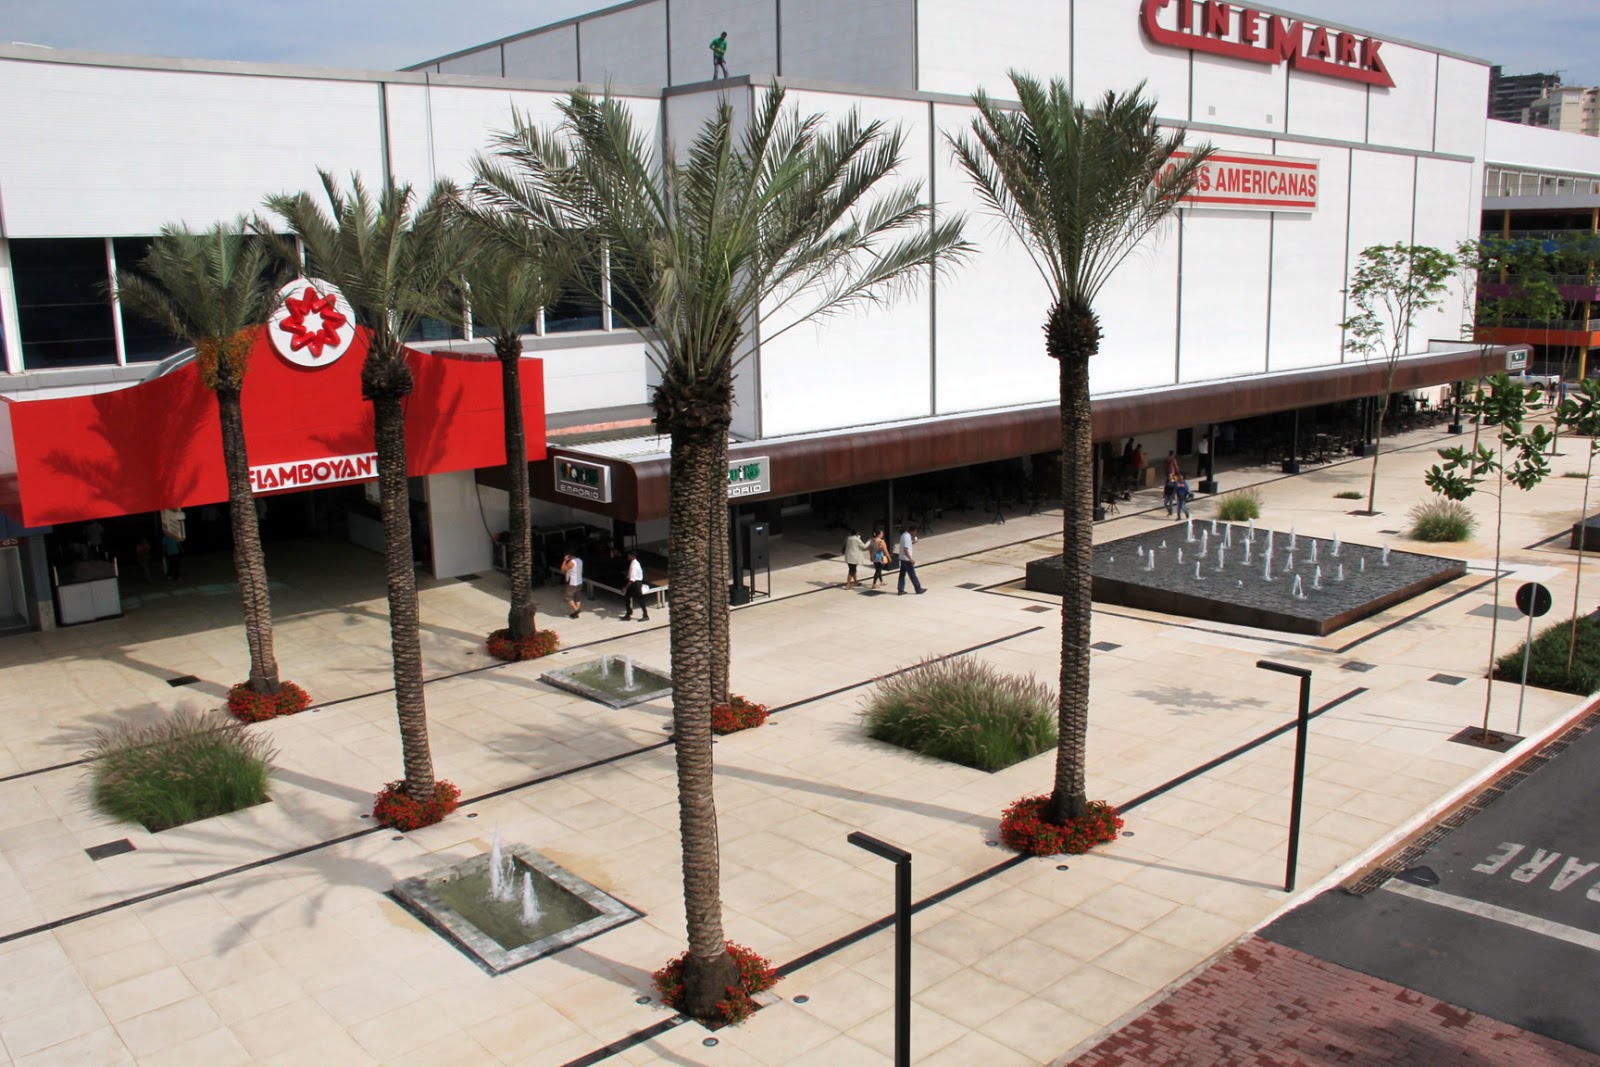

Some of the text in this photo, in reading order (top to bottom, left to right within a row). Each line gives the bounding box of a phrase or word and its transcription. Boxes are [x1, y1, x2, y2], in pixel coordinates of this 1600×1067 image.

[1140, 0, 1396, 88] CINEMARK
[1215, 167, 1317, 198] AMERICANAS
[1471, 841, 1600, 903] ARE
